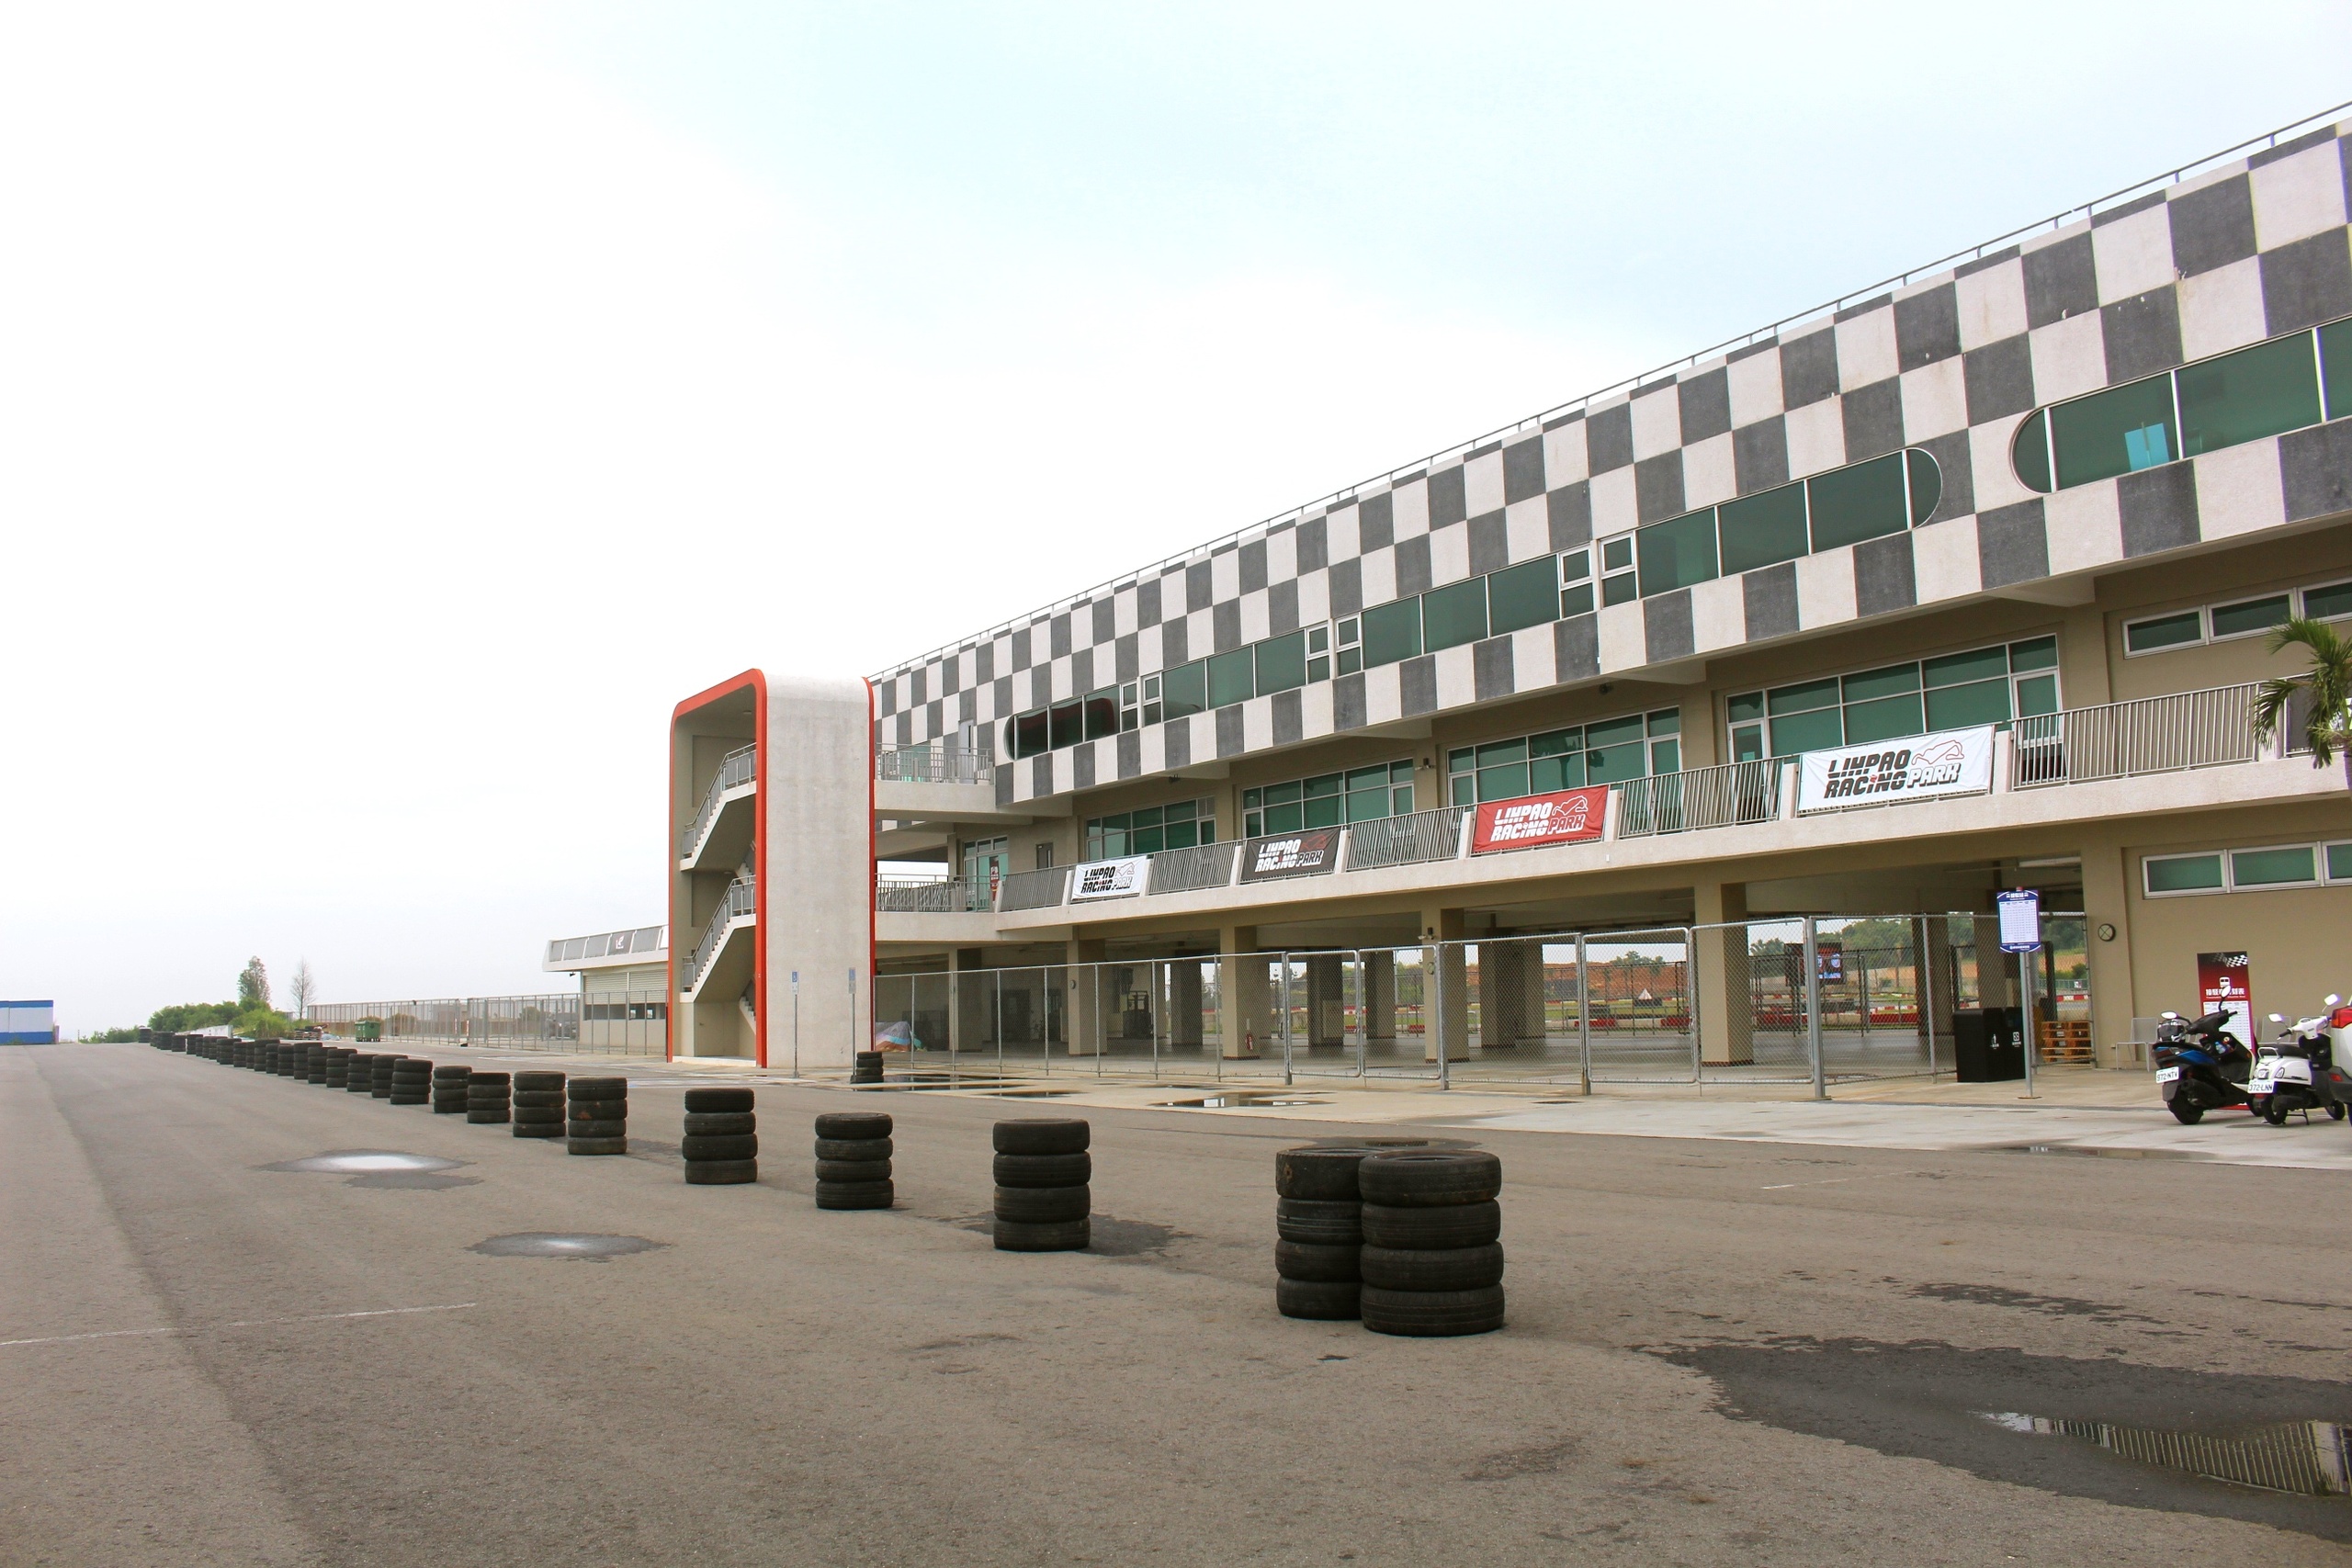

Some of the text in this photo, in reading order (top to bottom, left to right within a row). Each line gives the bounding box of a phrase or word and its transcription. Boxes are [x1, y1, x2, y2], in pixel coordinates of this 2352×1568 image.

[1827, 749, 1912, 778] LIHPAO
[1906, 762, 1962, 788] PARK
[1494, 802, 1554, 825] LIHPAO
[1547, 814, 1586, 835] PARK
[1296, 850, 1324, 867] PARK
